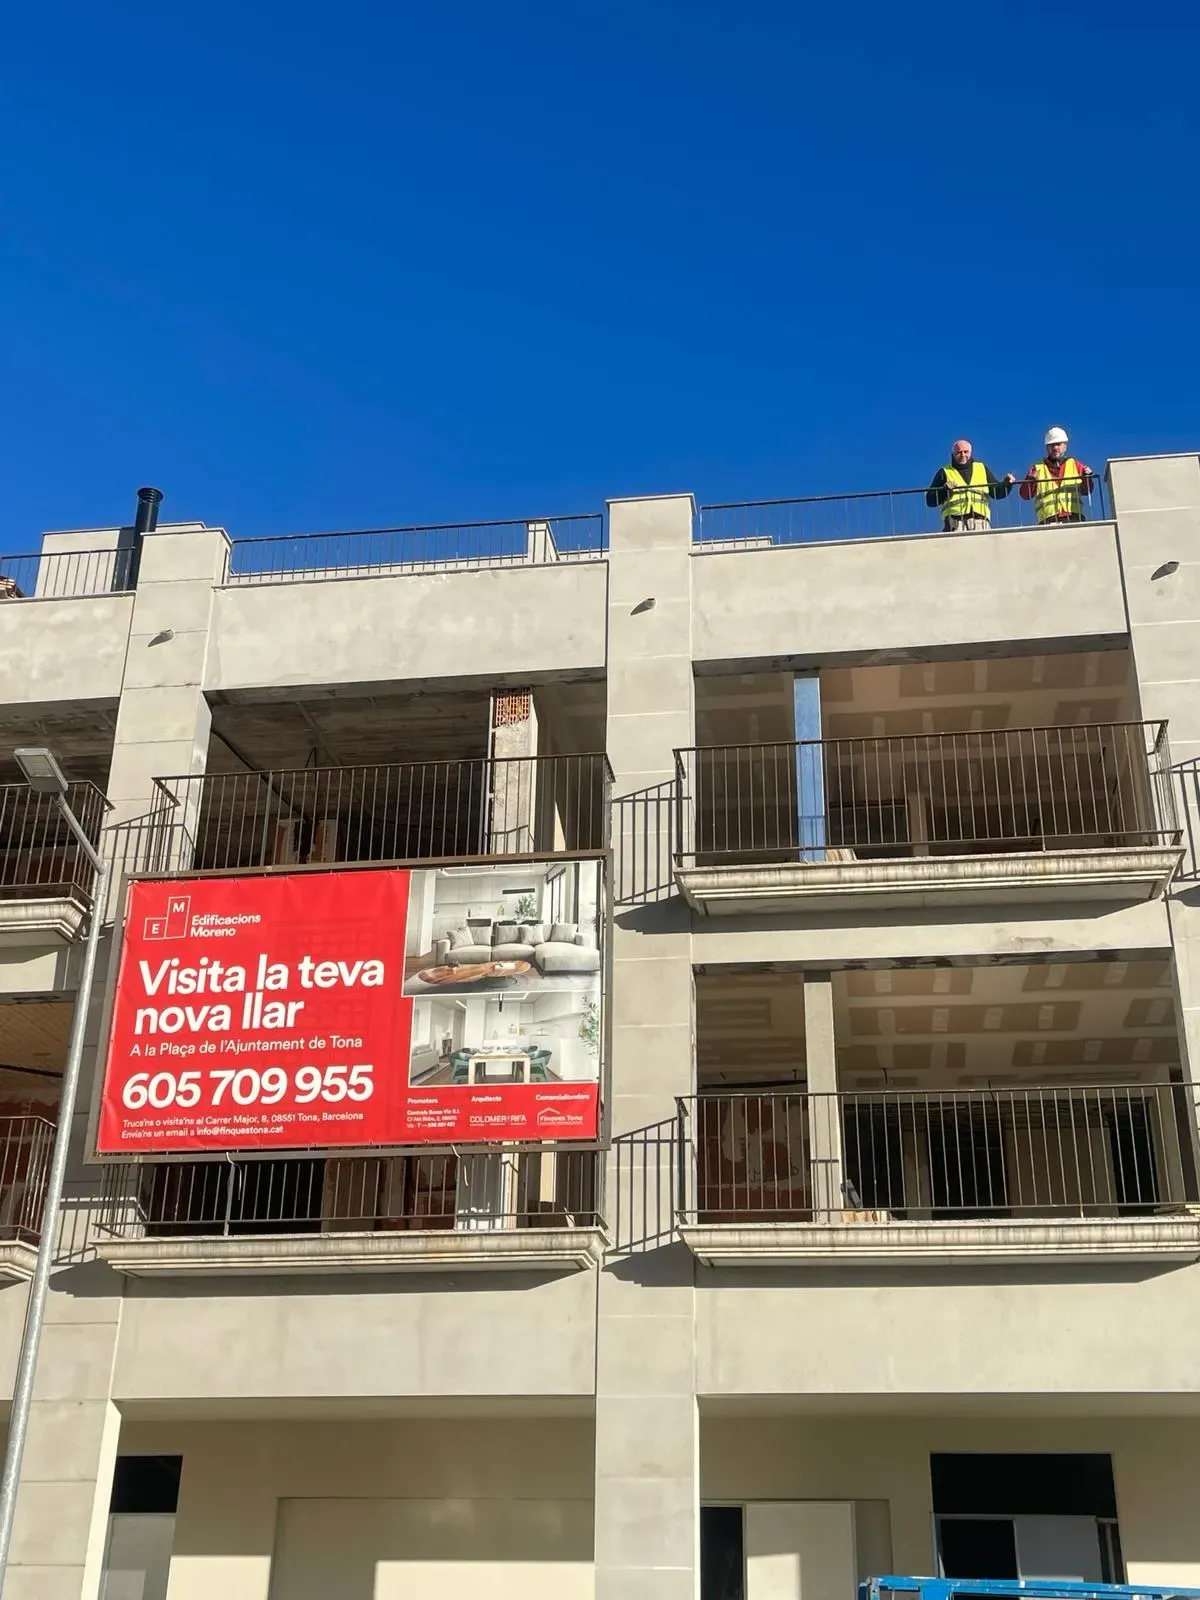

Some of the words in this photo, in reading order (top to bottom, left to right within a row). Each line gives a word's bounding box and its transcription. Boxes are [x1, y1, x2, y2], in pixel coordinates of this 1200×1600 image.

[172, 901, 186, 913] M
[191, 913, 262, 927] Edificacions
[151, 923, 160, 935] E
[190, 926, 236, 938] Moreno
[139, 956, 246, 996] Visita
[255, 953, 289, 991] la
[298, 955, 385, 989] teva
[134, 1003, 231, 1035] nova
[241, 991, 305, 1030] llar
[130, 1043, 141, 1057] A
[144, 1042, 157, 1056] la
[159, 1041, 195, 1057] Plaça
[199, 1040, 217, 1054] de
[220, 1038, 305, 1054] l'Ajuntament
[308, 1035, 326, 1049] de
[329, 1034, 363, 1049] Tona
[122, 1071, 202, 1110] 605
[208, 1067, 288, 1106] 709
[294, 1063, 374, 1104] 955
[196, 1116, 204, 1125] al
[205, 1115, 232, 1125] Carrer
[271, 1113, 296, 1123] 08551
[322, 1111, 364, 1122] Barcelona
[153, 1130, 165, 1138] un
[165, 1127, 189, 1137] email
[189, 1129, 195, 1137] a
[196, 1125, 284, 1137] info@finquestona.cat
